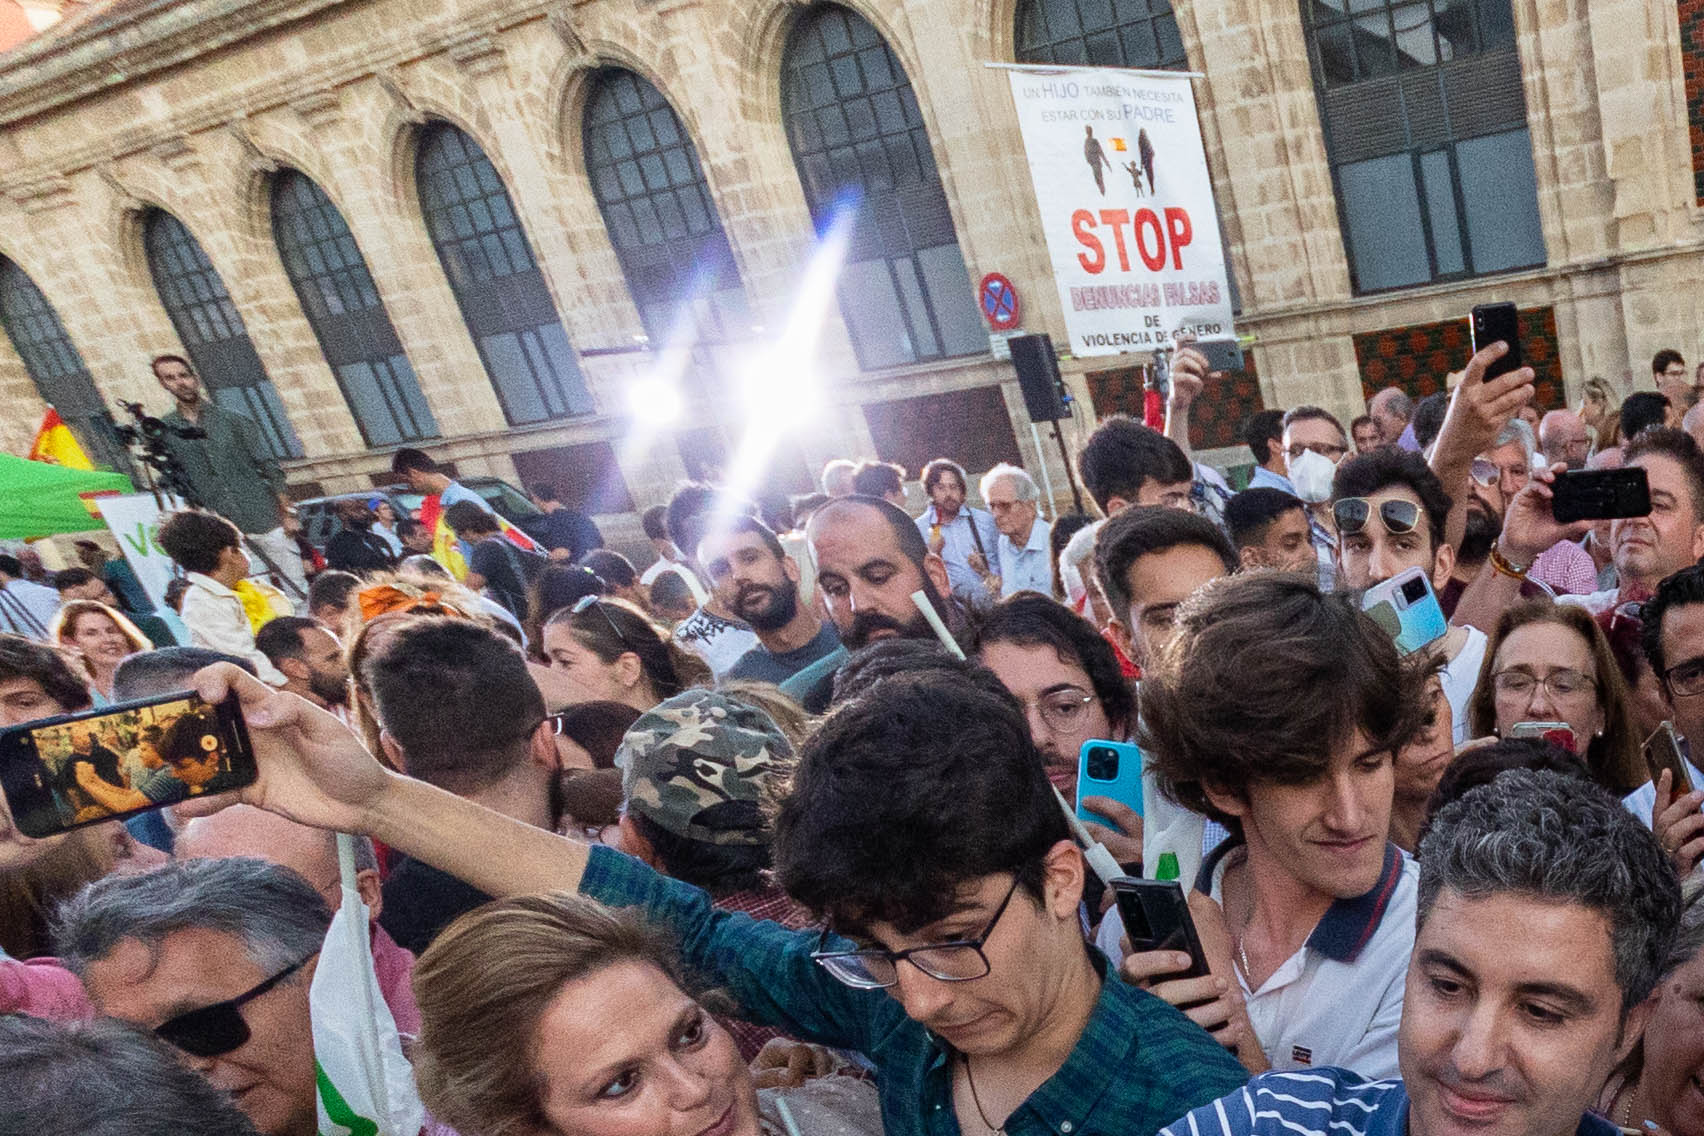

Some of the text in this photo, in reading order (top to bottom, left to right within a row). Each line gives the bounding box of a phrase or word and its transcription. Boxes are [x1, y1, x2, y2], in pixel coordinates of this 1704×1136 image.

[1023, 88, 1040, 98] UN
[1041, 82, 1079, 99] HIJO
[1132, 89, 1183, 104] NECESITA
[1041, 104, 1175, 124] ESTAR CON SU PADRE
[1071, 207, 1192, 274] STOP
[1070, 281, 1221, 312] DENUNCIAS FALSAS
[1144, 315, 1161, 328] DE
[1081, 333, 1151, 347] VIOLENCIA
